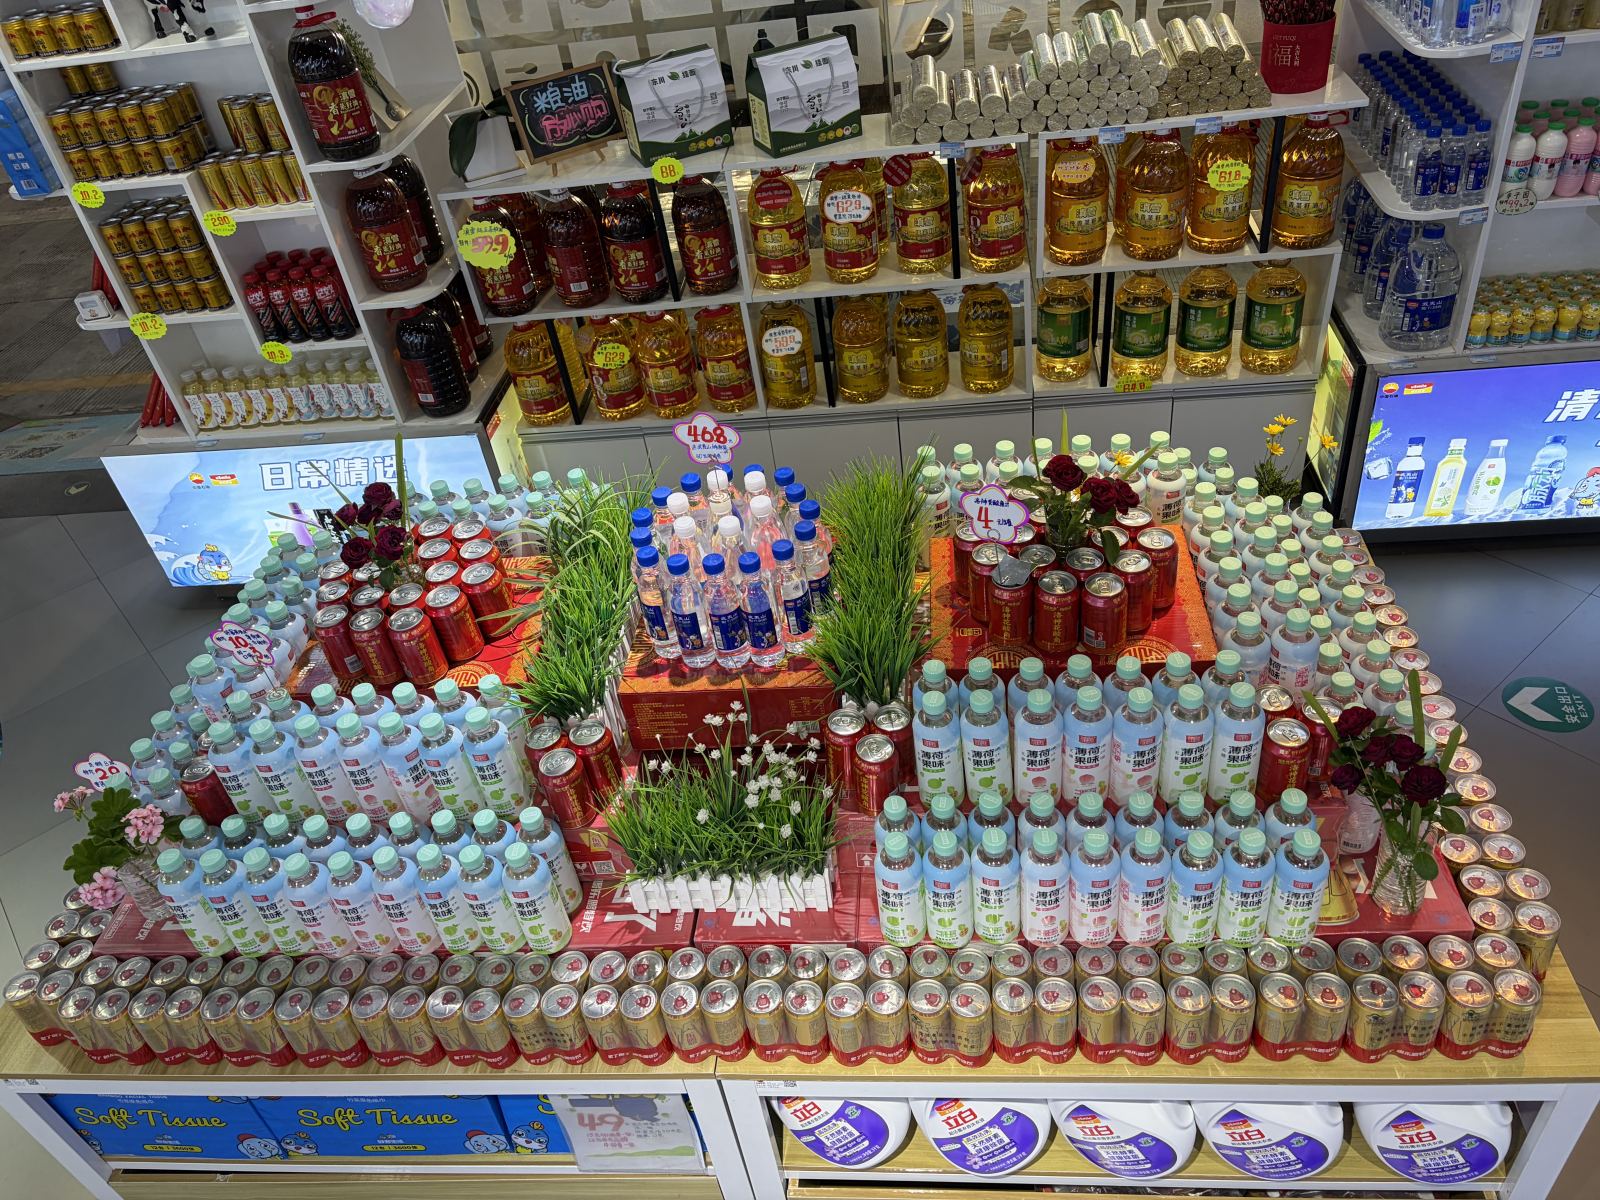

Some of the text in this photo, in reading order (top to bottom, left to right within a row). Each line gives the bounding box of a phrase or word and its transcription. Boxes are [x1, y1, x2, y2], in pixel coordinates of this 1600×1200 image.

[1273, 43, 1292, 67] 福
[533, 75, 589, 113] 粮油
[835, 200, 862, 213] 62.9
[1544, 389, 1600, 423] 清
[259, 454, 409, 492] 日常精选
[977, 507, 993, 529] 4
[228, 636, 248, 648] 10
[1554, 687, 1580, 723] 安全出口
[1572, 694, 1588, 717] EXIT
[921, 750, 944, 759] 薄荷
[972, 750, 995, 759] 薄荷
[1026, 750, 1049, 759] 薄荷
[1075, 747, 1100, 757] 薄荷
[1134, 749, 1157, 759] 薄荷
[1181, 747, 1204, 757] 薄荷
[1228, 746, 1251, 755] 薄荷
[922, 759, 945, 767] 果味
[972, 758, 995, 767] 果味
[1026, 758, 1050, 767] 果味
[1074, 755, 1100, 764] 果味
[1132, 757, 1157, 768] 果味
[1179, 755, 1204, 765] 果味
[1227, 754, 1251, 763] 果味
[307, 770, 326, 779] 薄荷
[348, 770, 368, 778] 薄荷
[430, 769, 449, 778] 薄荷
[475, 765, 495, 775] 薄荷
[221, 774, 240, 784] 薄荷
[263, 774, 282, 783] 薄荷
[352, 777, 372, 786] 果味
[433, 777, 453, 785] 果味
[479, 772, 499, 782] 果味
[225, 782, 245, 791] 果味
[268, 782, 287, 790] 果味
[310, 778, 330, 787] 果味
[1036, 892, 1060, 900] 薄荷
[1087, 891, 1112, 900] 薄荷
[1142, 890, 1165, 900] 薄荷
[1190, 893, 1216, 902] 薄荷
[1237, 892, 1262, 900] 薄荷
[1287, 892, 1314, 900] 薄荷
[383, 902, 402, 911] 薄荷
[428, 902, 448, 911] 薄荷
[468, 902, 486, 911] 薄荷
[515, 901, 535, 910] 薄荷
[1036, 899, 1060, 907] 果味
[1086, 899, 1112, 907] 果味
[1140, 898, 1165, 907] 果味
[1190, 901, 1214, 910] 果味
[215, 904, 235, 914] 薄荷
[257, 903, 277, 914] 薄荷
[297, 908, 315, 917] 薄荷
[339, 906, 359, 916] 薄荷
[518, 908, 539, 917] 果味
[219, 912, 240, 921] 果味
[262, 911, 282, 920] 果味
[343, 913, 362, 922] 果味
[386, 910, 405, 919] 果味
[432, 909, 453, 918] 果味
[472, 909, 490, 918] 果味
[300, 915, 319, 923] 果味
[791, 1101, 821, 1122] 立白
[74, 1107, 228, 1130] Soft Tissue
[297, 1108, 458, 1131] Soft Tissue
[942, 1108, 977, 1130] 立白
[1077, 1125, 1114, 1136] 立白
[1226, 1129, 1265, 1142] 立白
[1395, 1130, 1437, 1144] 立白
